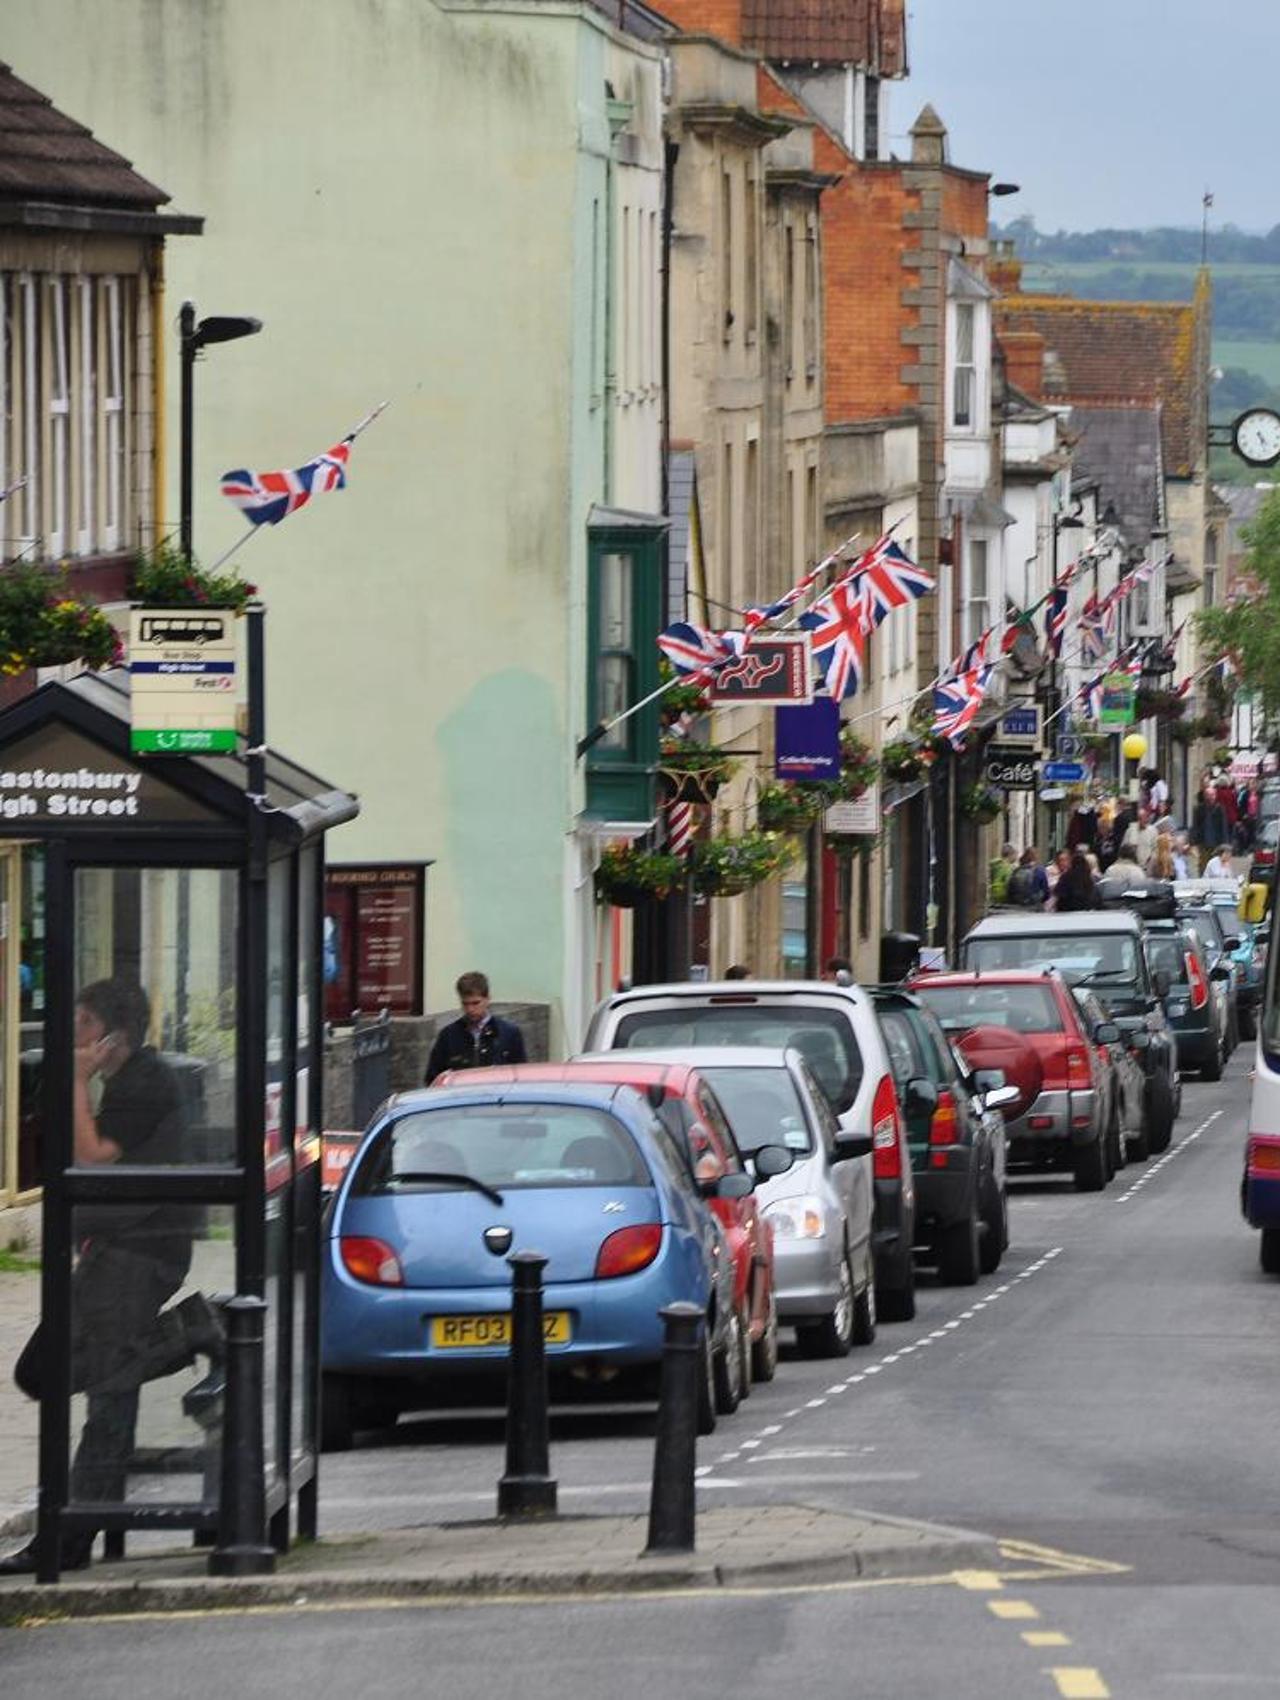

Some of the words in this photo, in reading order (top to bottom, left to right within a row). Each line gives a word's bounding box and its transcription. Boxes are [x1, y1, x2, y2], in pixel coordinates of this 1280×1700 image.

[0, 768, 141, 793] astonbury
[987, 761, 1034, 781] Café
[47, 794, 138, 815] Street
[442, 1317, 506, 1342] RF03
